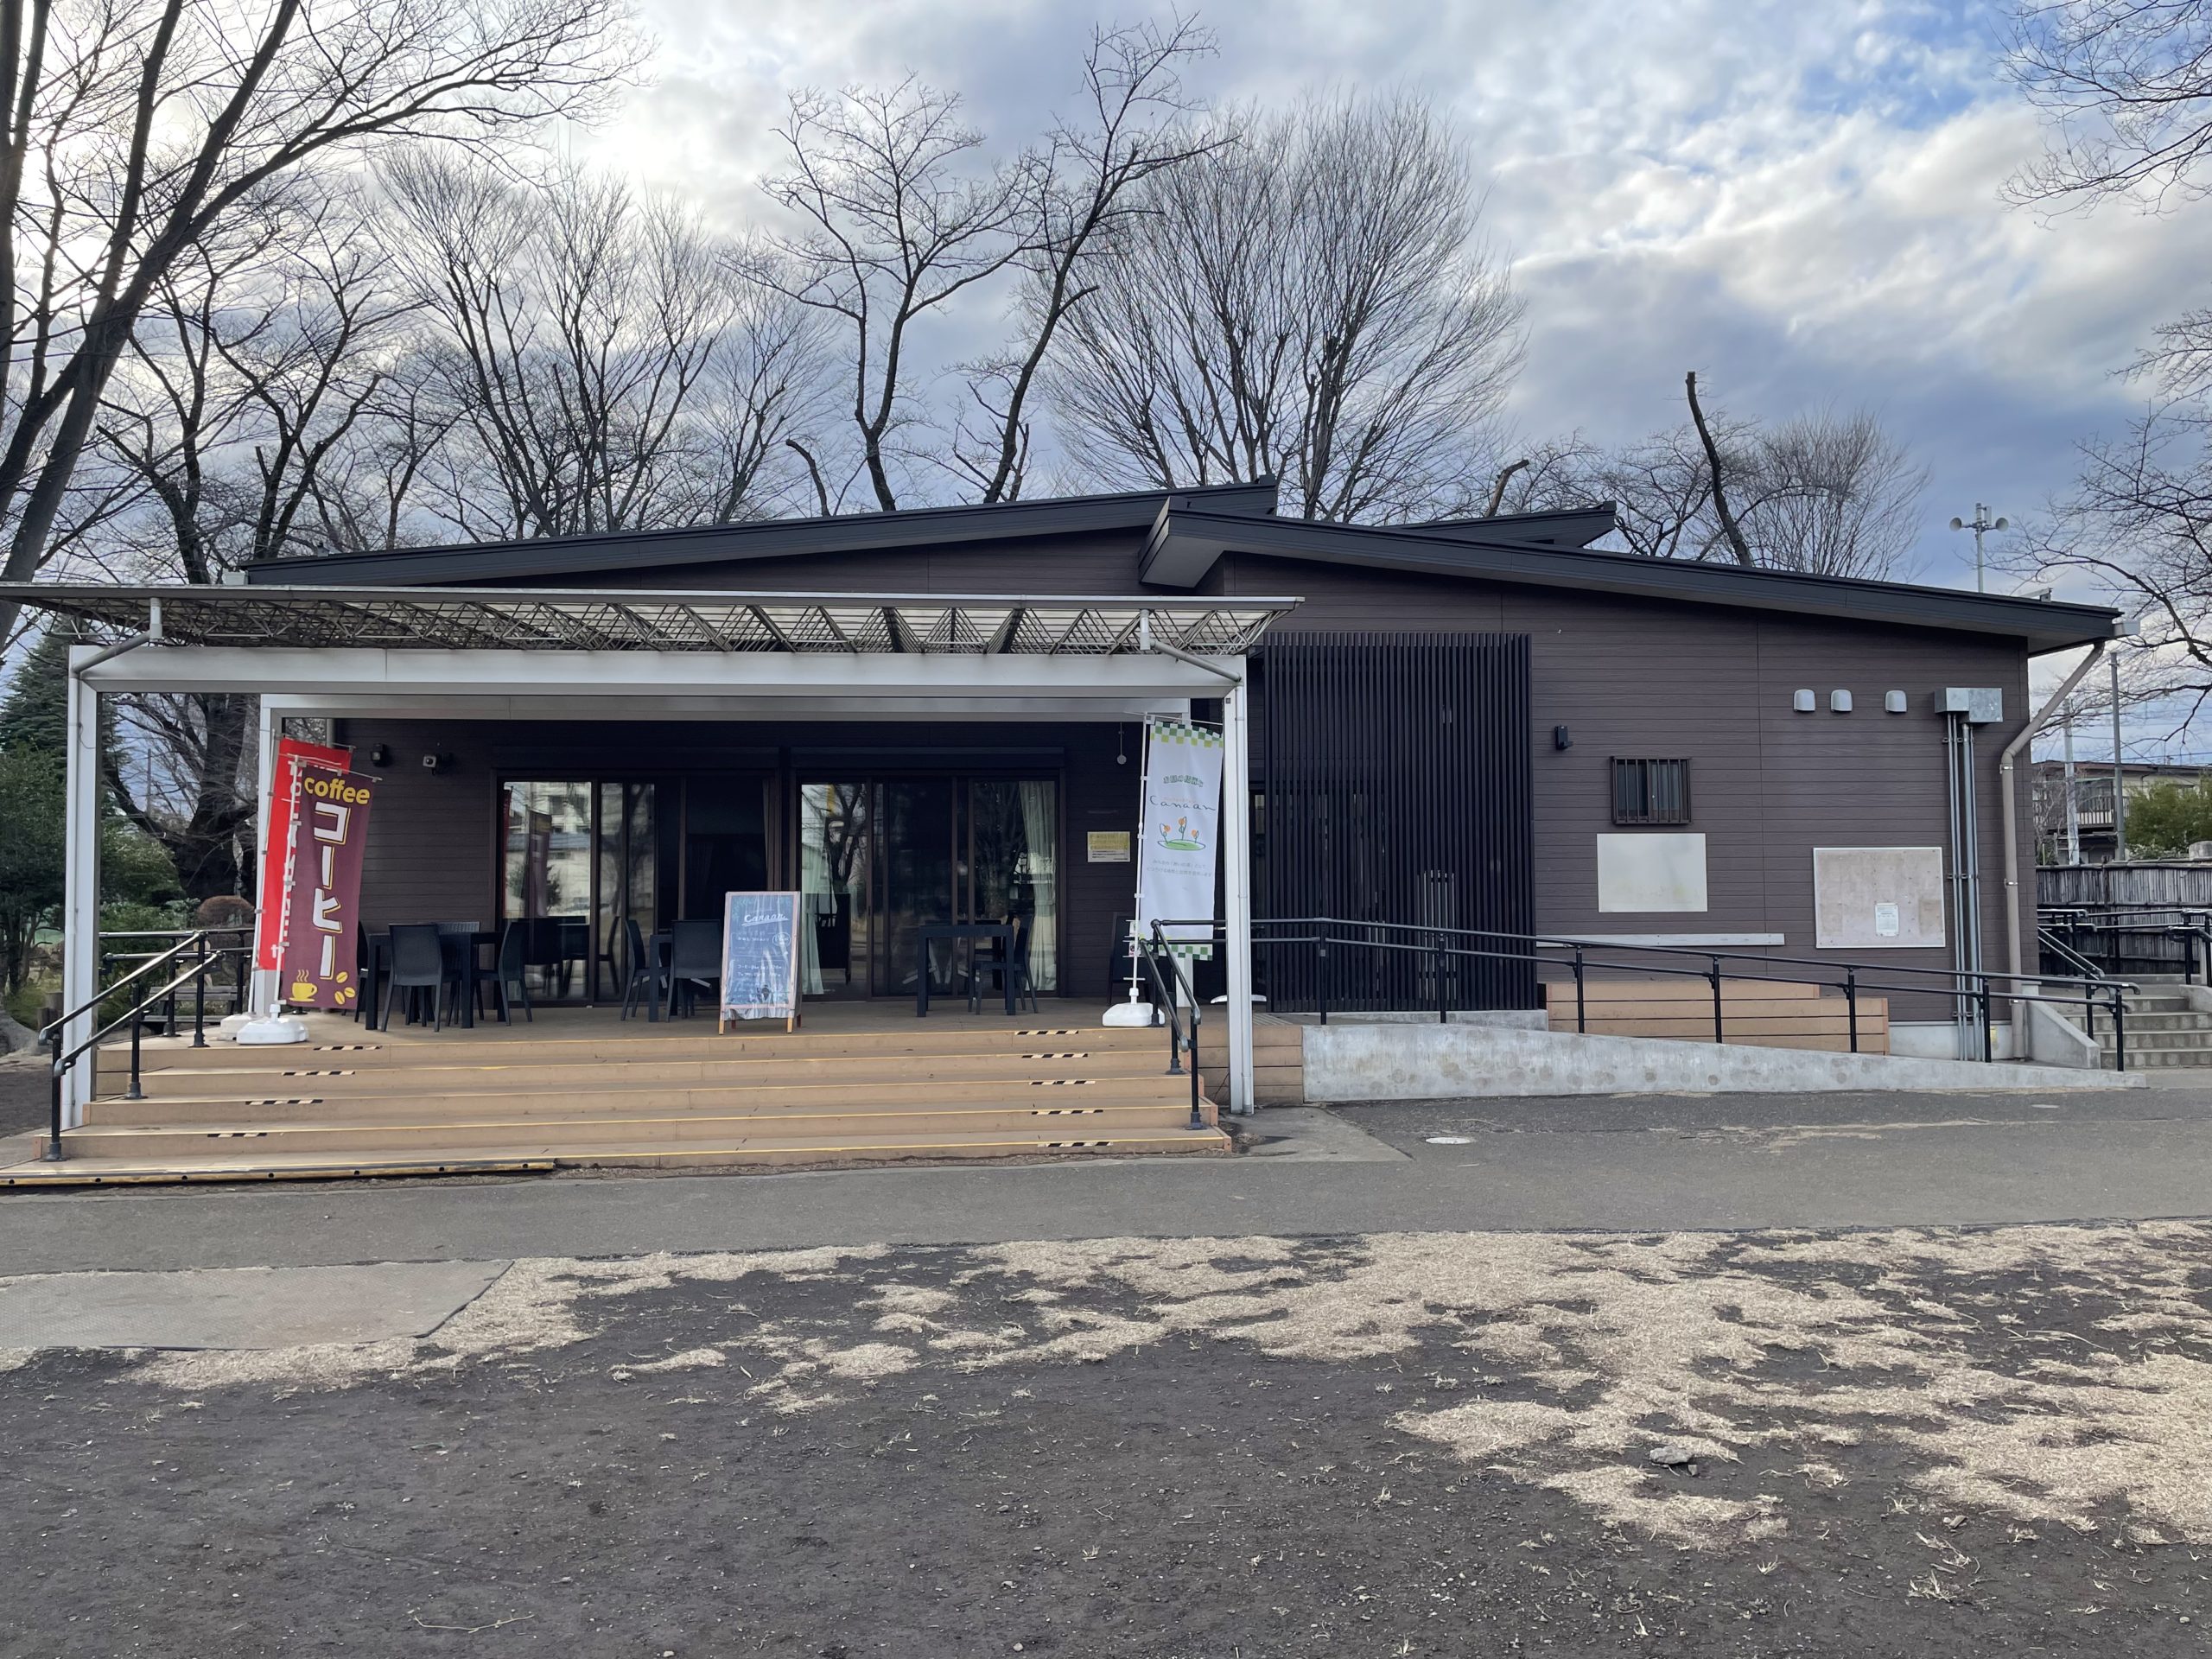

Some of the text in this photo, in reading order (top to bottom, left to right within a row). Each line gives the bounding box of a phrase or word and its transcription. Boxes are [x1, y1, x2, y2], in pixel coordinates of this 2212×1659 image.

[304, 777, 371, 804] coffee
[1150, 795, 1216, 810] Canaan
[312, 802, 350, 980] コーヒー
